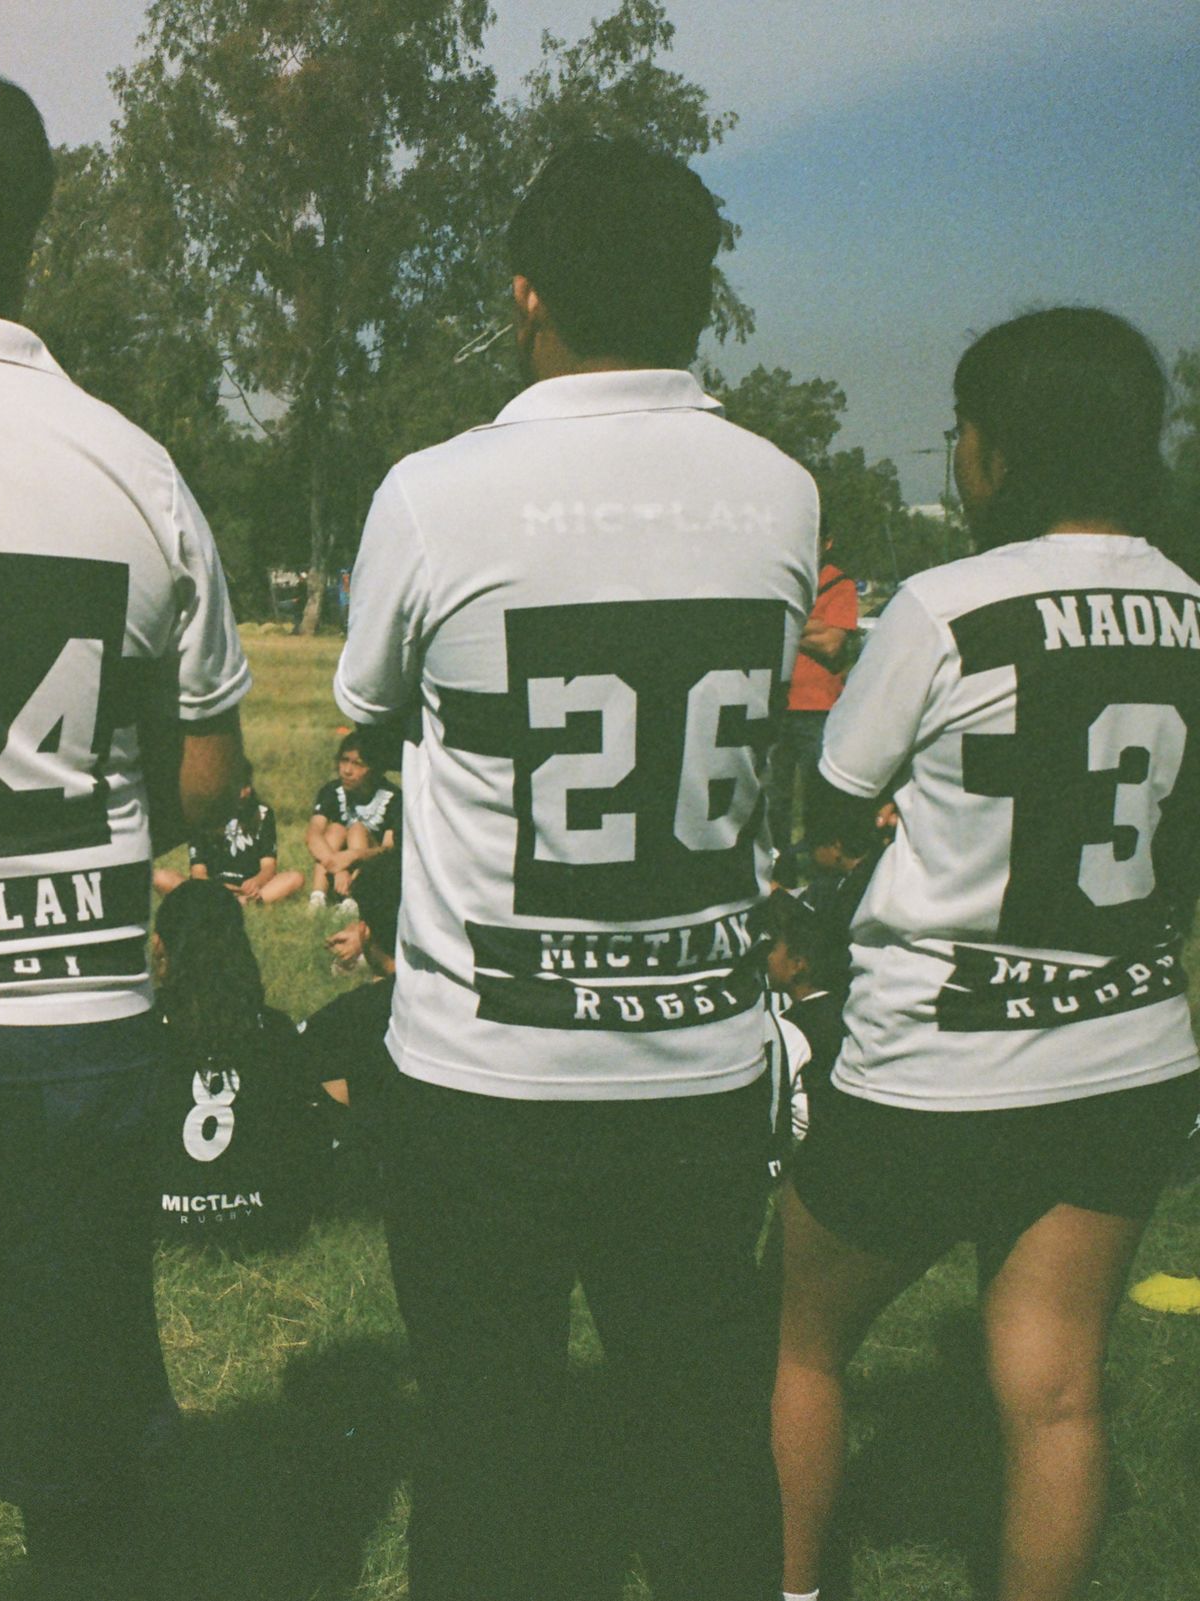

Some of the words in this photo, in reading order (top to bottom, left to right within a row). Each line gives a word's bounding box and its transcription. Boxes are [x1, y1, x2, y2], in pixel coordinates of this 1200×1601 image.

[523, 500, 774, 536] MICTLAN
[1035, 594, 1200, 650] NAOM
[527, 669, 772, 865] 26
[1077, 704, 1188, 906] 3
[540, 913, 752, 970] MICTLAN
[182, 1066, 240, 1162] 8
[161, 1191, 264, 1213] MICTLAN
